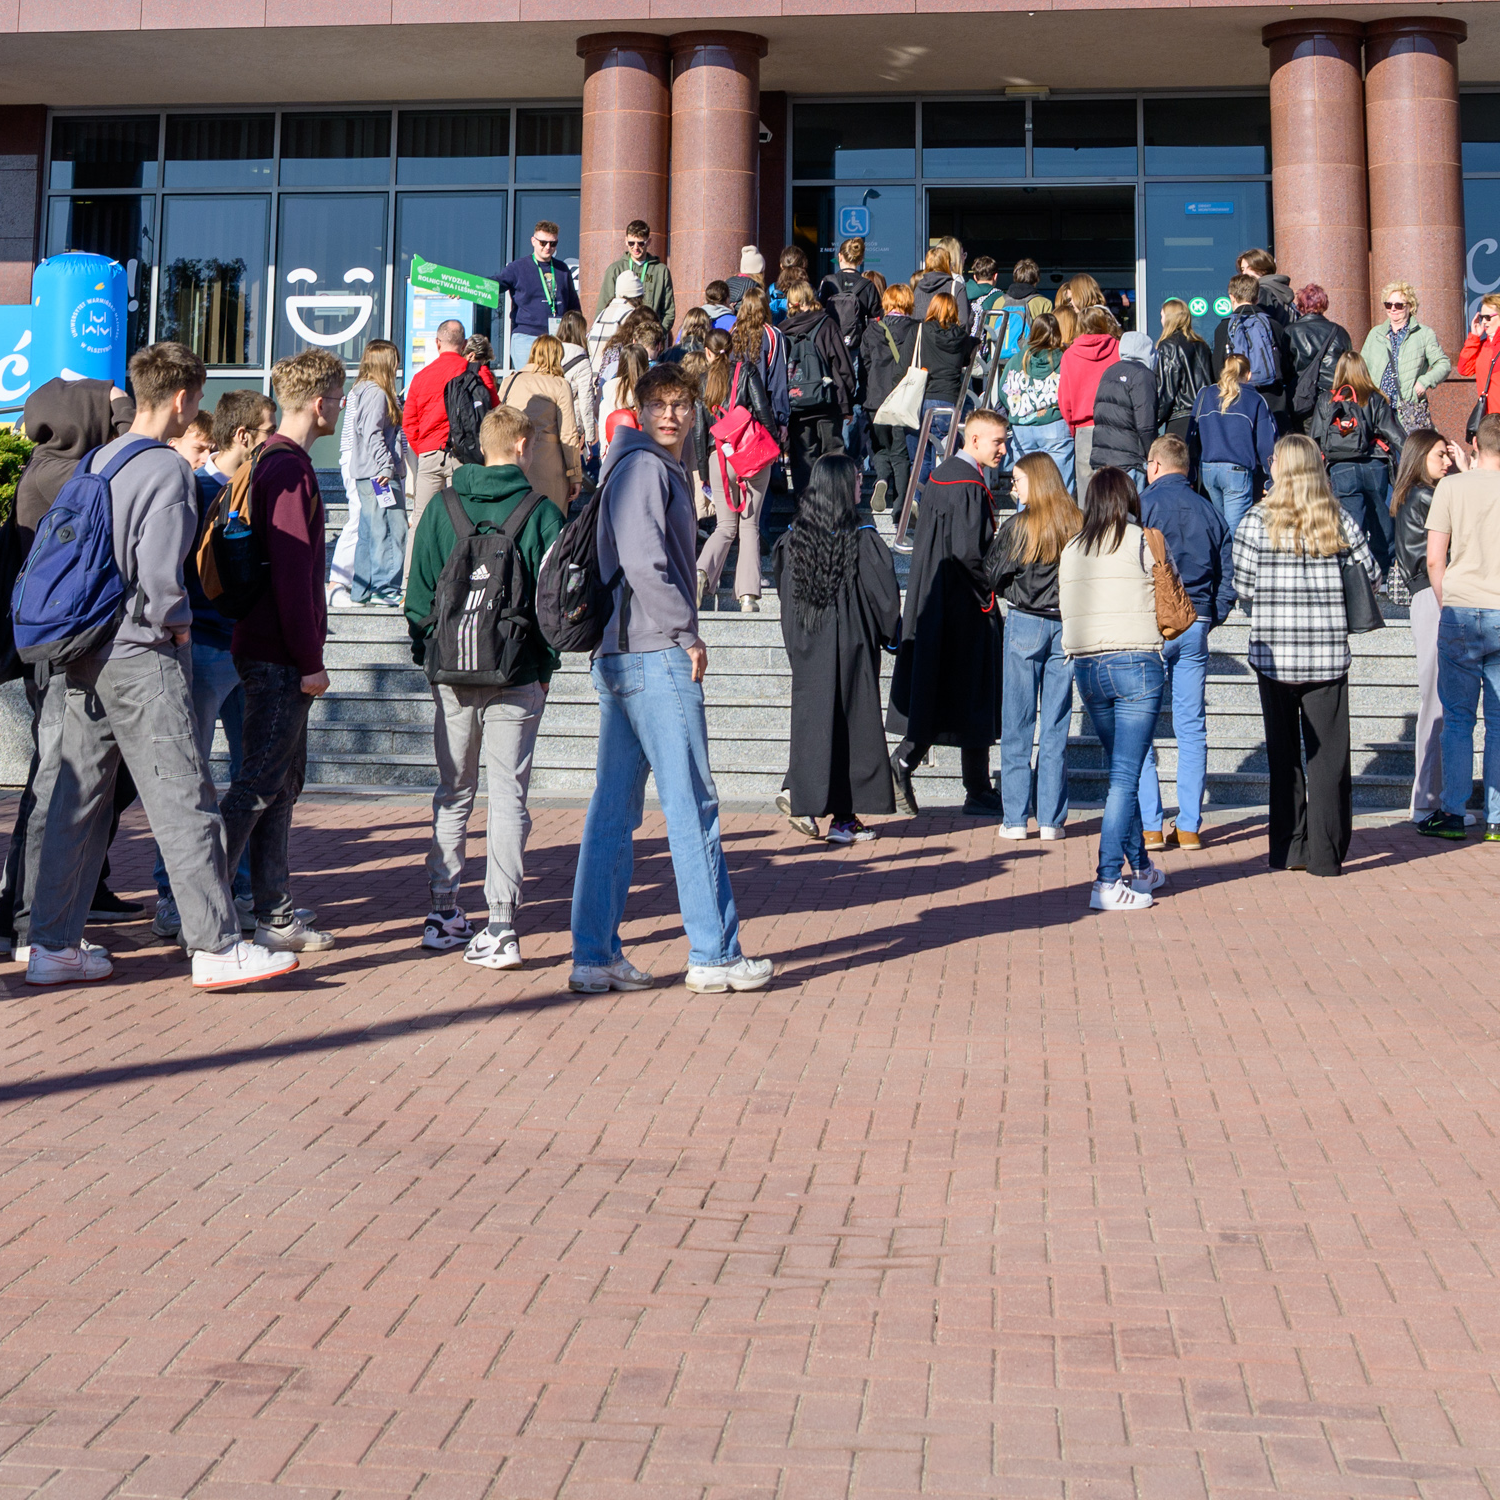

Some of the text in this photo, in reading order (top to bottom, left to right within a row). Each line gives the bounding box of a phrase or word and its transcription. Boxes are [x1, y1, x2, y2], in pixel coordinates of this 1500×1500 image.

[441, 273, 470, 287] WYDZIAŁ
[418, 275, 454, 289] ROLNICTWA
[457, 284, 492, 300] LEŚNICTWA
[469, 572, 490, 580] adidas
